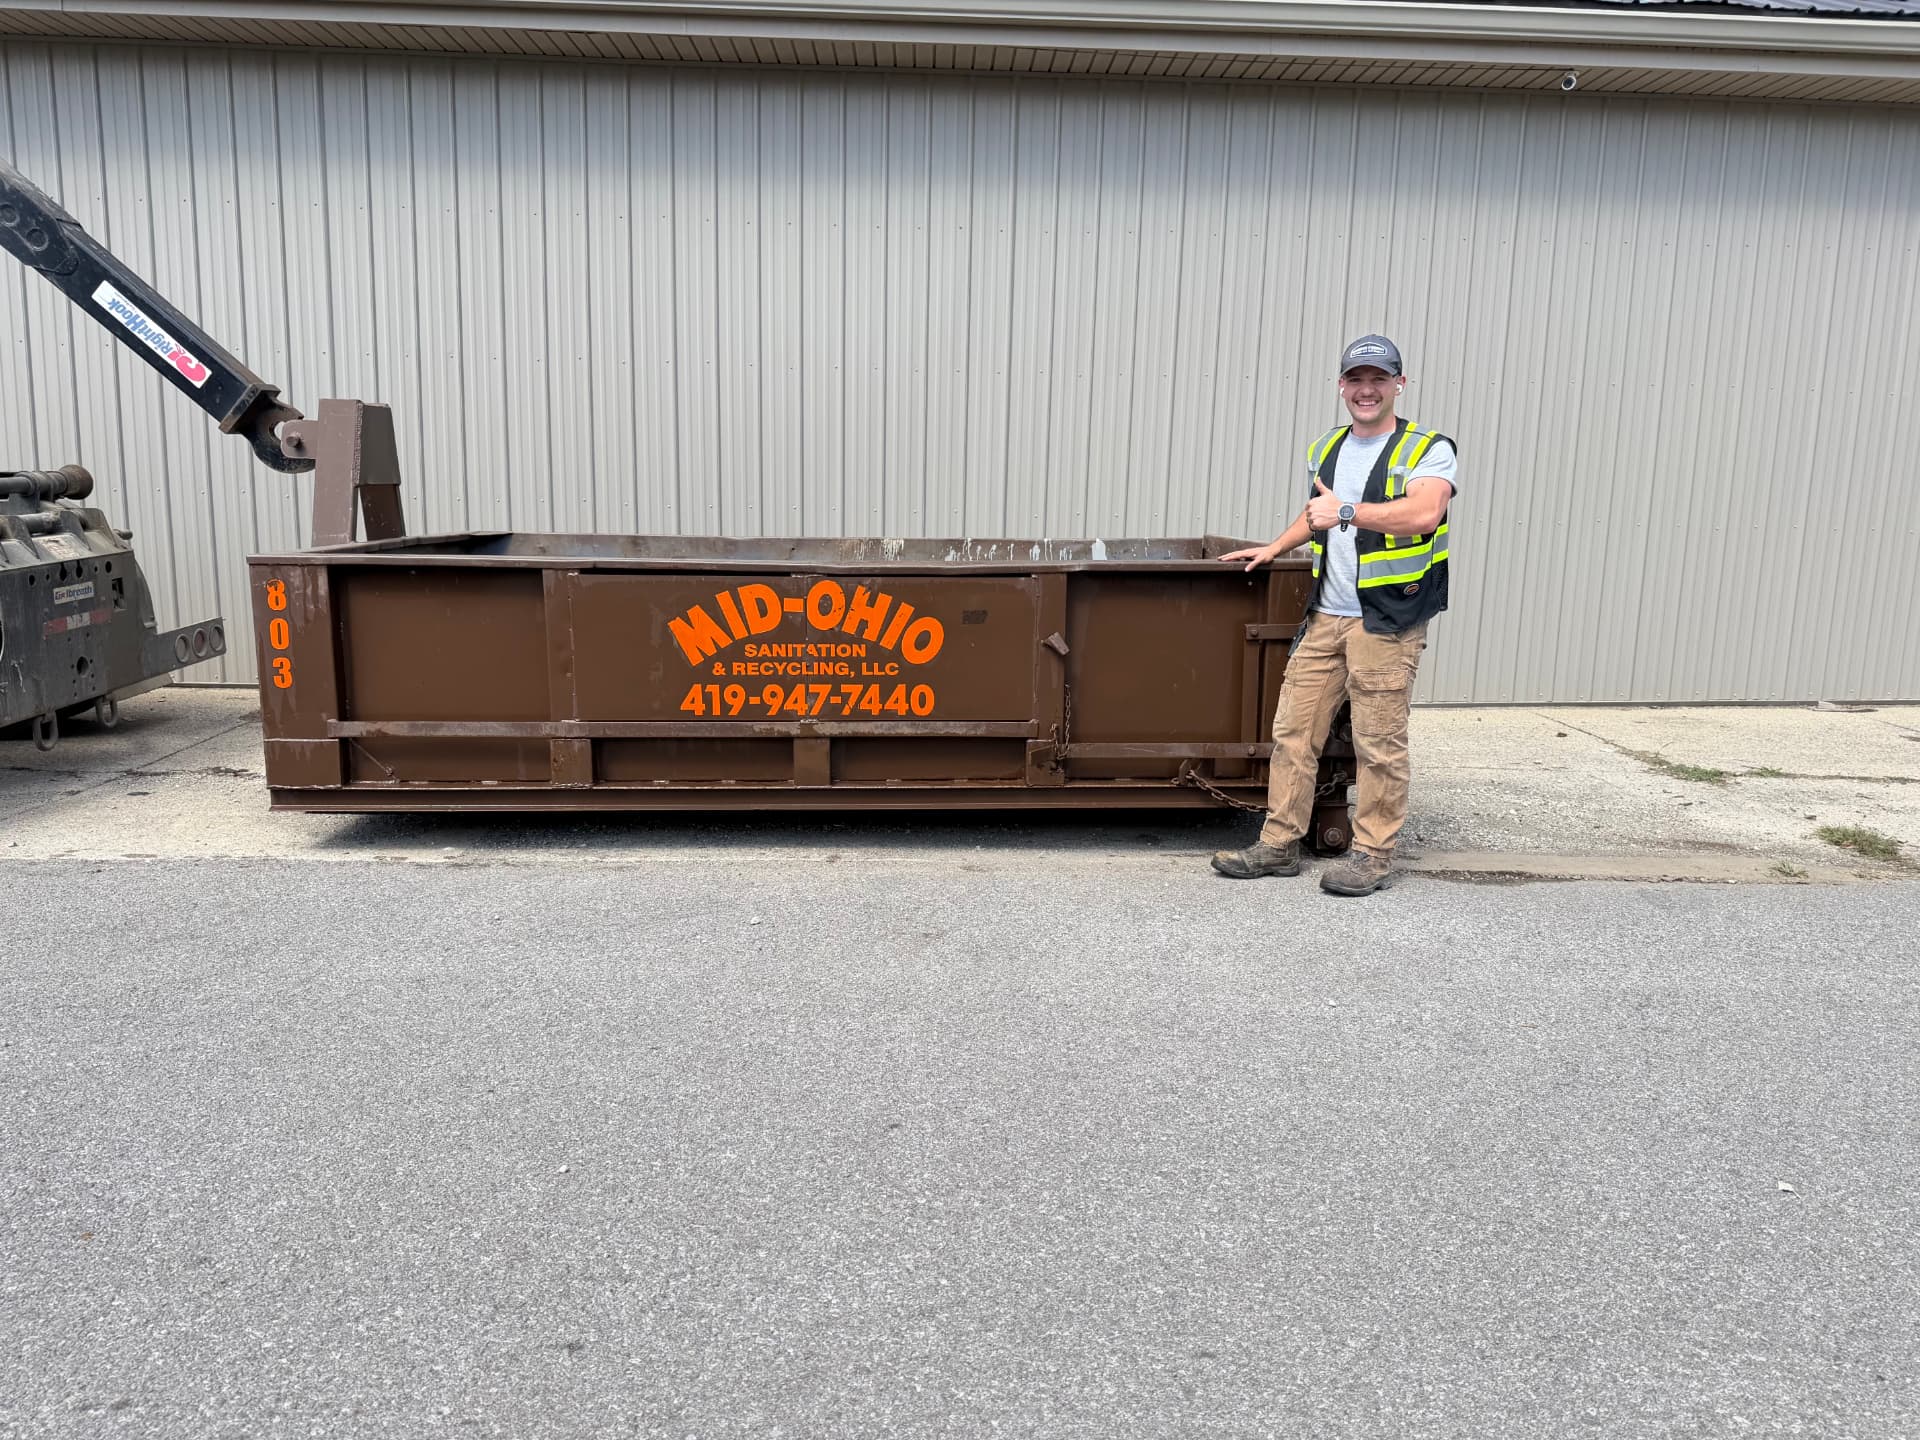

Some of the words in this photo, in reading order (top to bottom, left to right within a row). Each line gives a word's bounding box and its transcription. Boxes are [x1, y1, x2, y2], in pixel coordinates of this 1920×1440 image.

[108, 298, 173, 355] RightHook
[266, 578, 294, 690] 803
[668, 580, 945, 666] MID-OHIO
[711, 662, 727, 676] &
[732, 662, 855, 678] RECYCLING,
[861, 662, 901, 676] LLC
[744, 643, 867, 658] SANITATION
[680, 684, 936, 716] 419-947-7440
